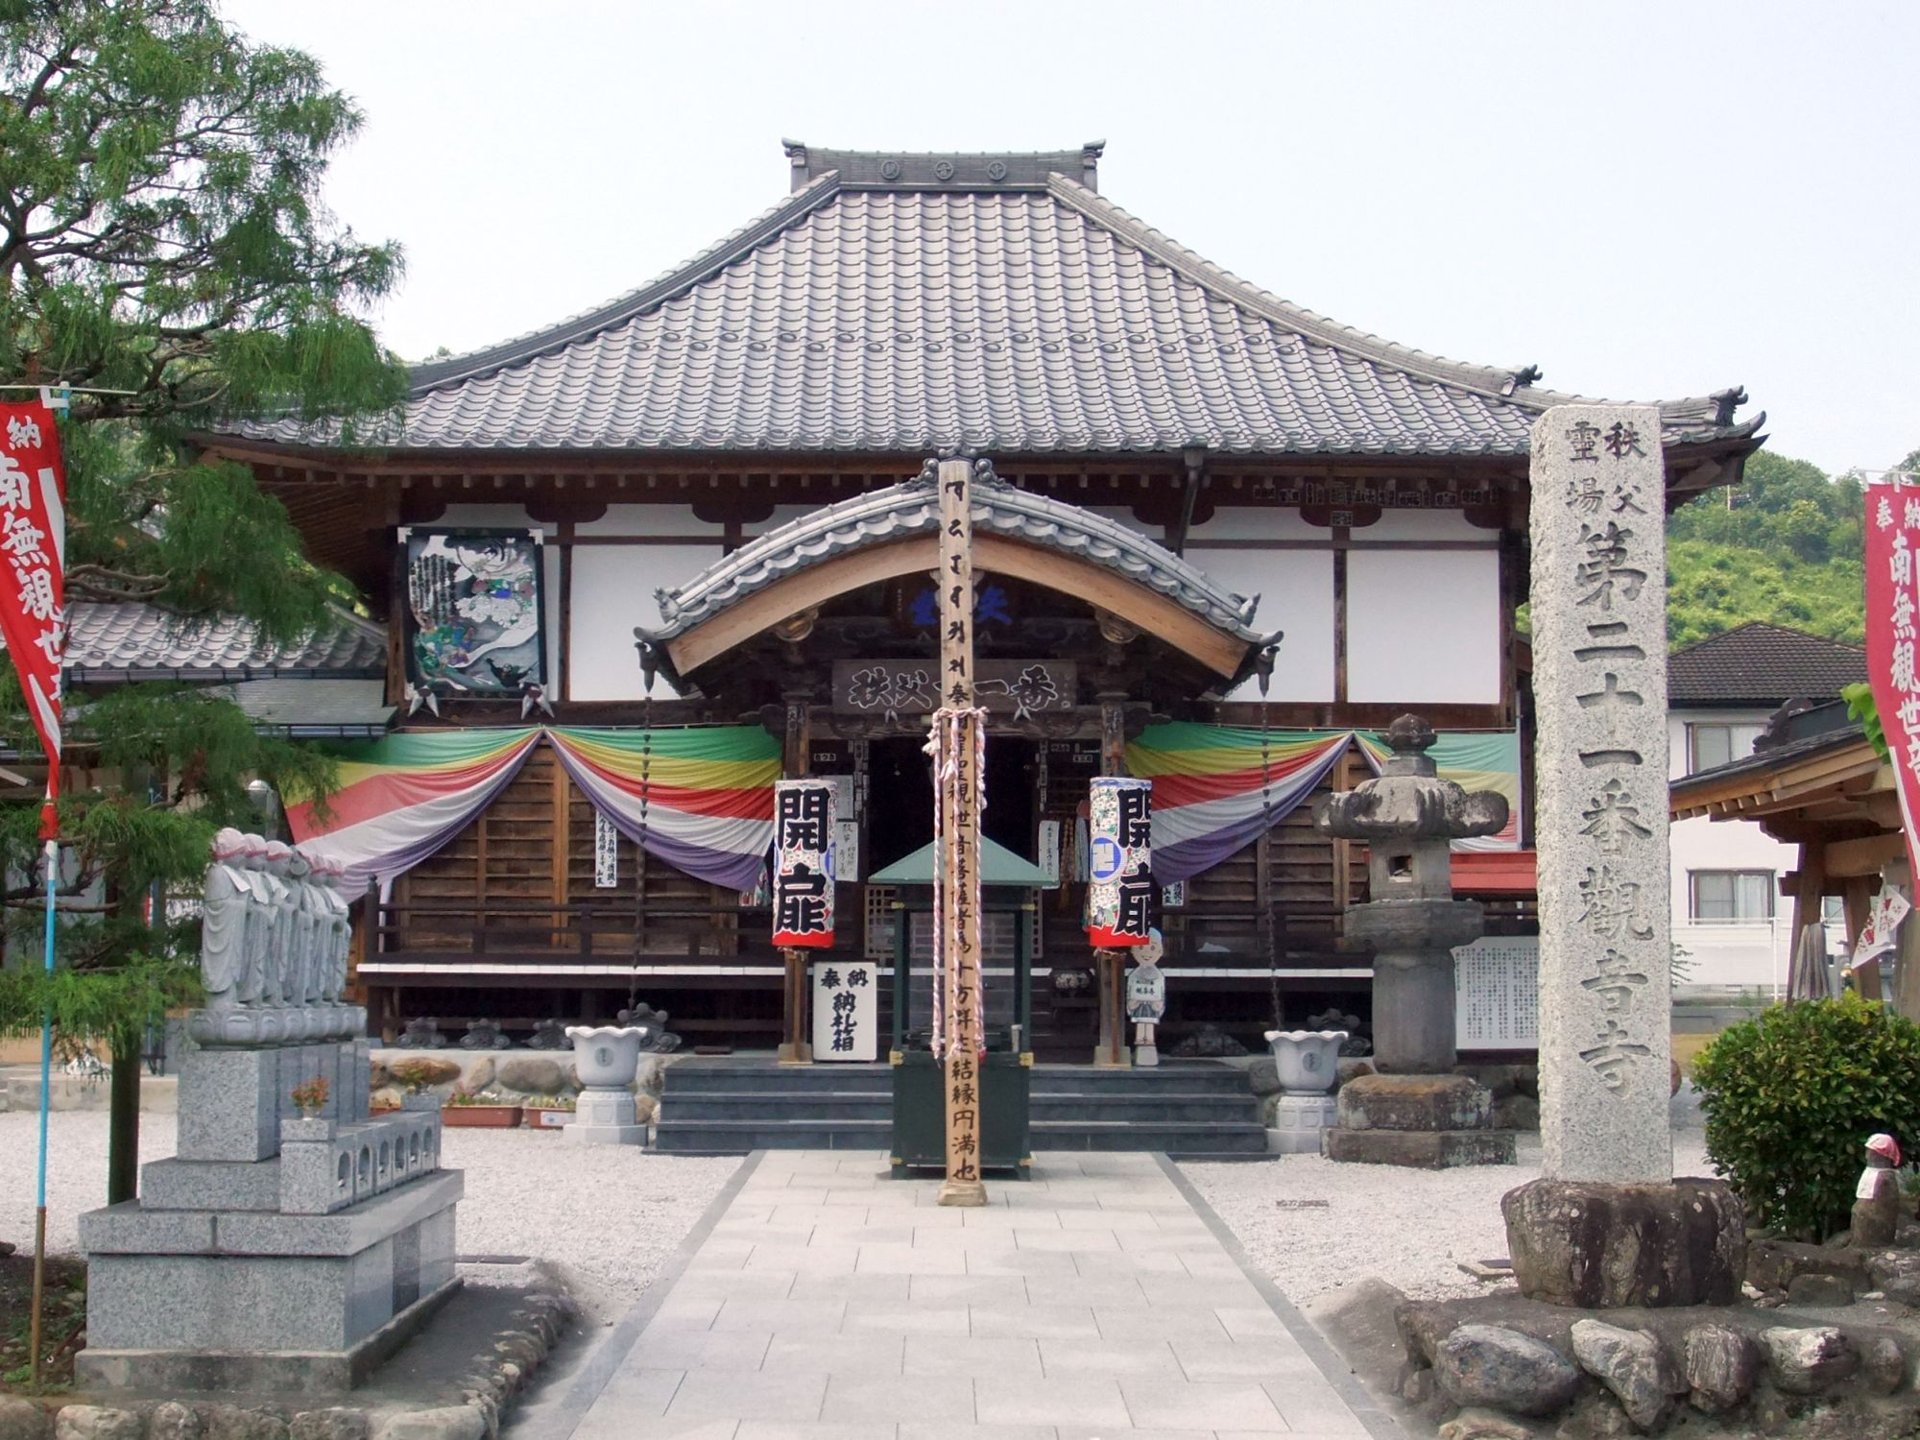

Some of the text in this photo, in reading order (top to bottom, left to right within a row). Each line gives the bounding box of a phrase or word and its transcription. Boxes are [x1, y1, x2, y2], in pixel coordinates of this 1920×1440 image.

[1604, 421, 1648, 515] 秩父
[776, 786, 831, 934] 開扉
[820, 967, 869, 990] 奉納
